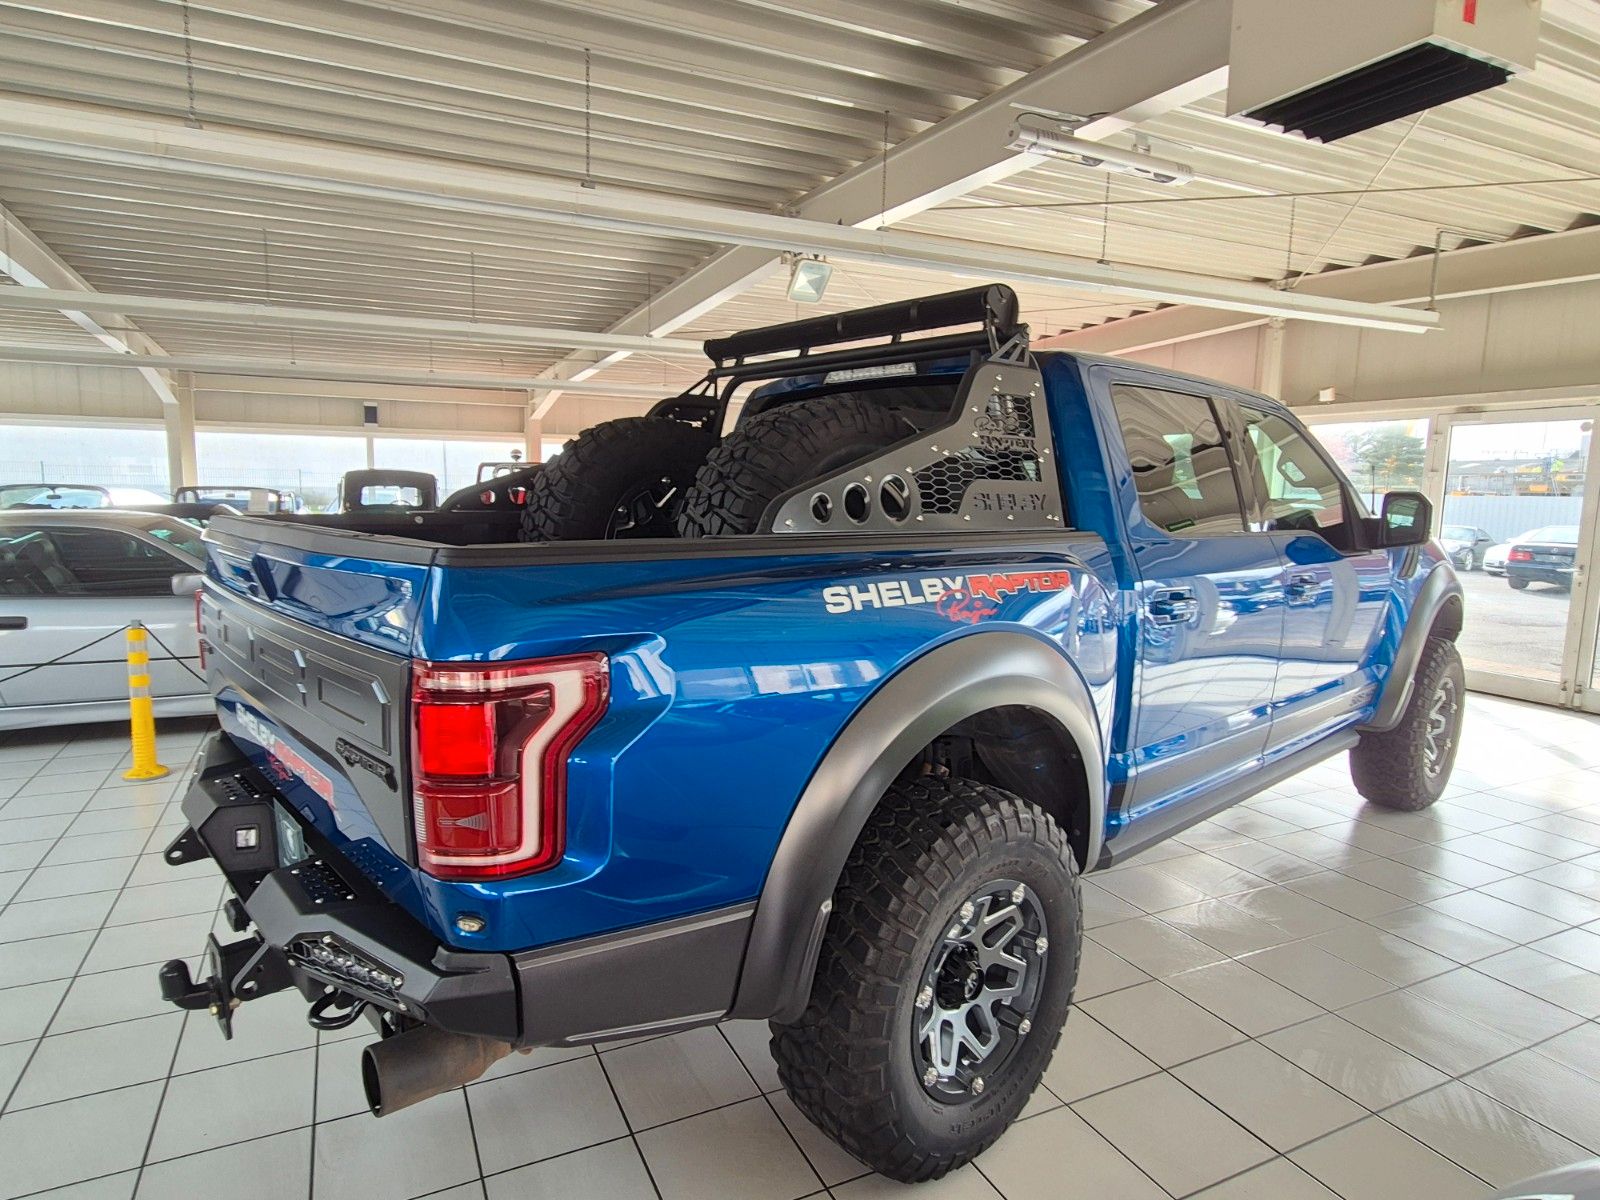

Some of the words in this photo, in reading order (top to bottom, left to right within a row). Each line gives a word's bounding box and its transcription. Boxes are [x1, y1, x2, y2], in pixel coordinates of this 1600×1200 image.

[973, 493, 1047, 511] SHELBY
[822, 576, 964, 614] SHELBY
[965, 570, 1074, 603] RAPTOR
[235, 701, 276, 751] SHELBY
[334, 736, 398, 793] RAPTOR
